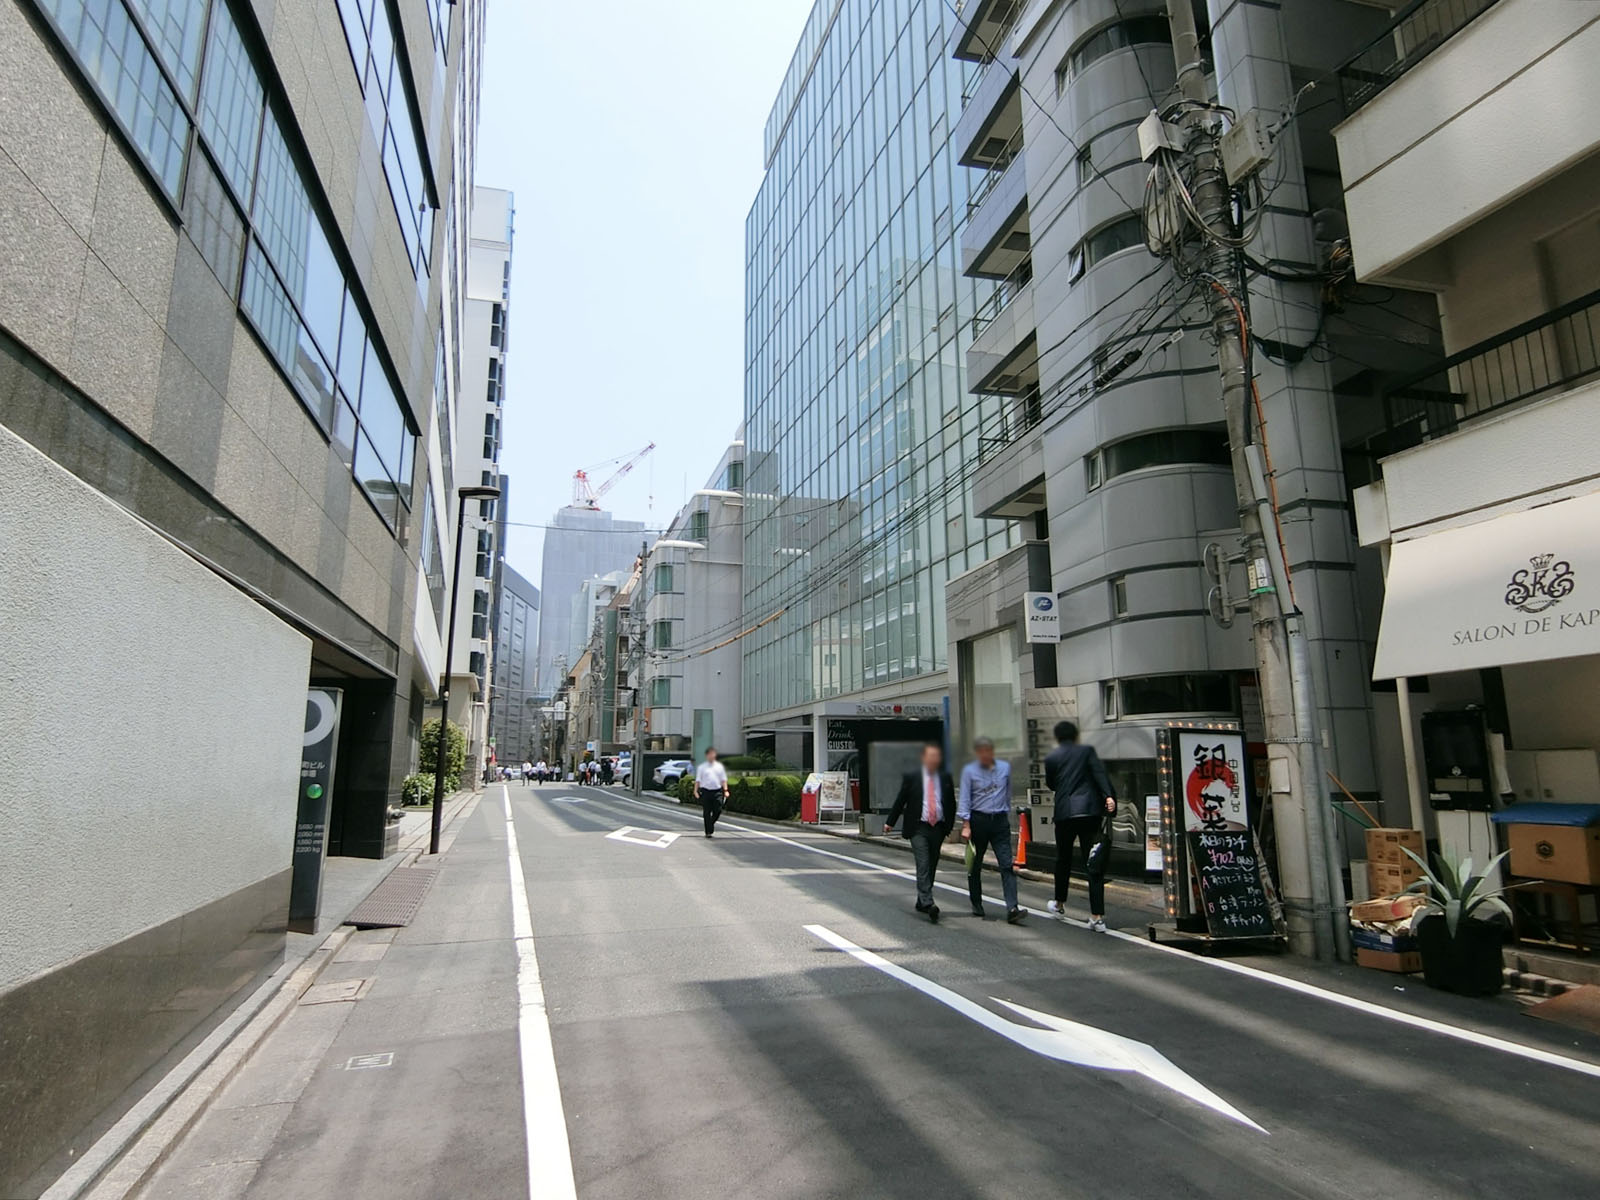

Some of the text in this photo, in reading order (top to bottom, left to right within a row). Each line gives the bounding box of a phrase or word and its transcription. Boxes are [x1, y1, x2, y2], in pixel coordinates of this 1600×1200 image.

[1452, 608, 1600, 646] SALON DE KAP
[828, 729, 855, 740] Drink,
[1199, 833, 1247, 850] 本日のランチ
[1208, 849, 1235, 866] ¥702
[1202, 875, 1210, 889] A
[1208, 902, 1215, 914] B
